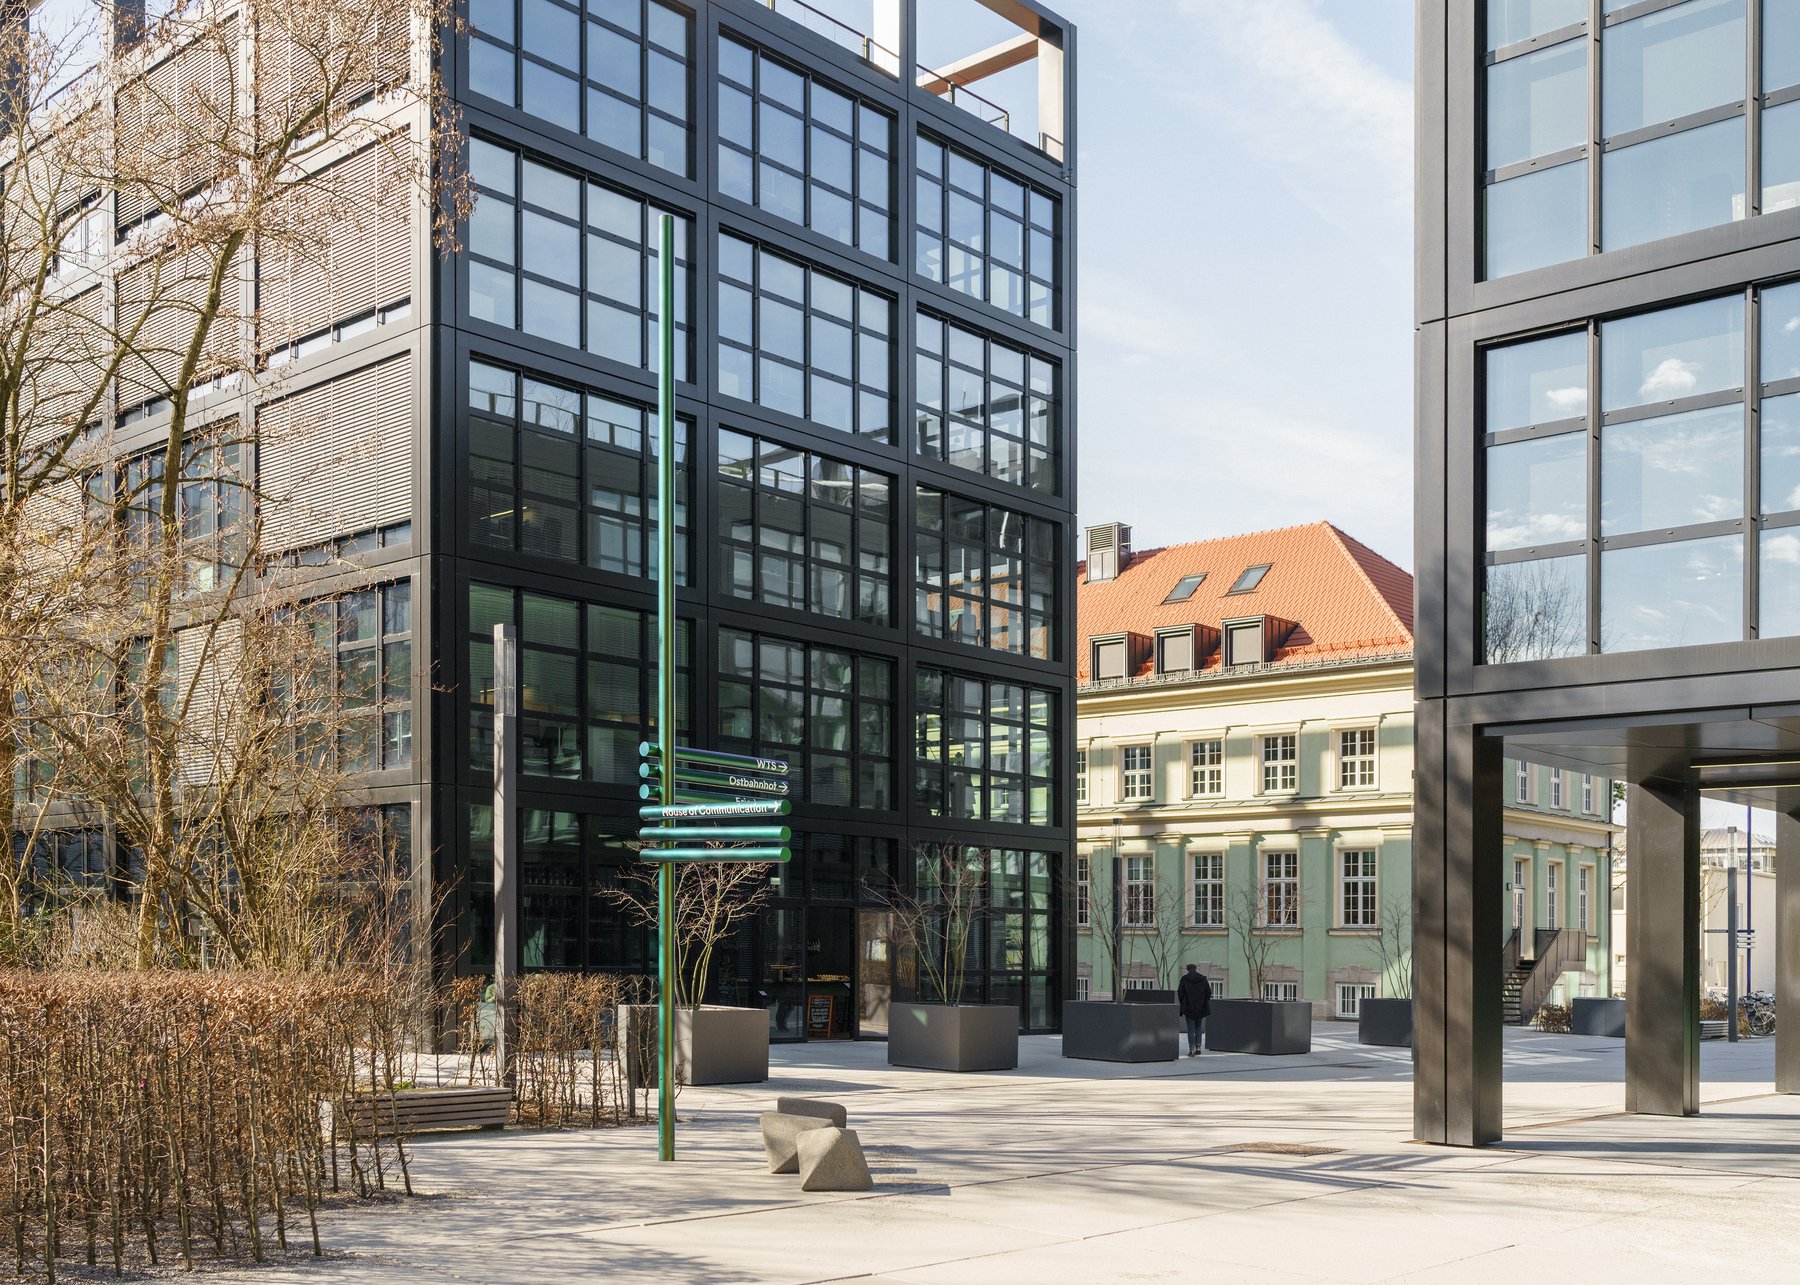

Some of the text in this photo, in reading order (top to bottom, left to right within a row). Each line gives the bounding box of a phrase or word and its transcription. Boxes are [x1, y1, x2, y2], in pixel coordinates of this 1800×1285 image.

[756, 759, 777, 770] WTS
[729, 776, 777, 791] Ostbahnhof
[662, 801, 767, 817] House of Communication
